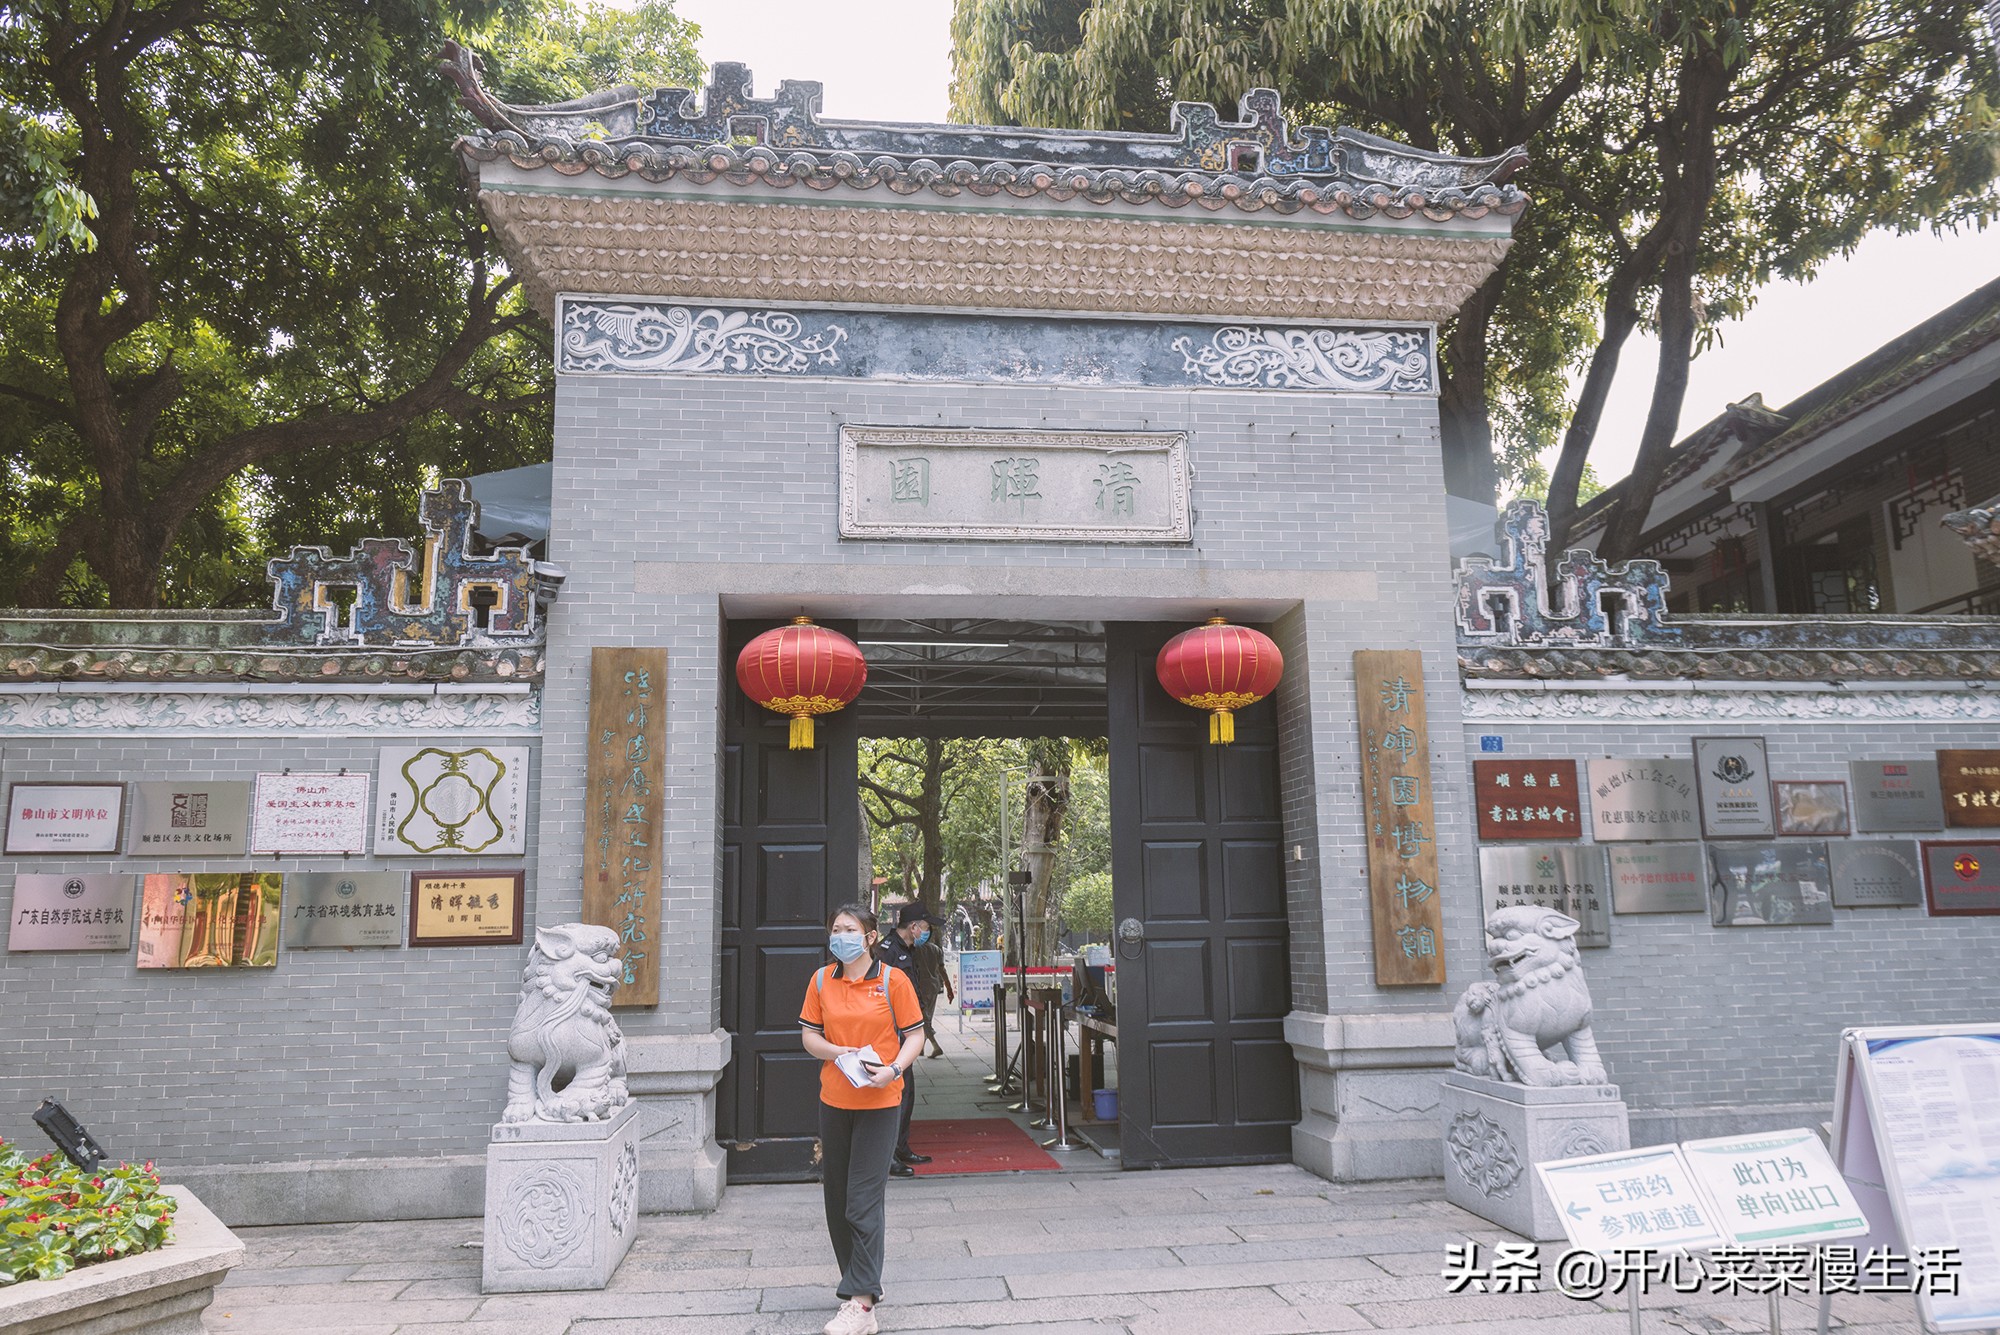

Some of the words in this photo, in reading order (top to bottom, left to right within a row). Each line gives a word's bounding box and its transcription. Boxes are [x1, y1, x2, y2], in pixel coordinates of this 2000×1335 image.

[295, 786, 329, 795] 佛山市
[1597, 769, 1690, 799] 顺德区工会会员
[266, 800, 356, 809] 爱国主义教育基地
[21, 808, 108, 821] 佛山市文明单位
[387, 792, 397, 842] 佛山市人民政府
[1602, 810, 1690, 823] 优惠服务定点单位
[142, 834, 232, 843] 顺德区公共文化场所
[1499, 883, 1594, 895] 顺德职业技术学院
[18, 907, 124, 925] 广东自然学院试点学校
[294, 903, 396, 918] 广东省环境教育基地
[1732, 1156, 1808, 1187] 此门为
[1596, 1174, 1674, 1204] 已预约
[1736, 1184, 1840, 1220] 单向出口
[1599, 1203, 1705, 1240] 参观通道
